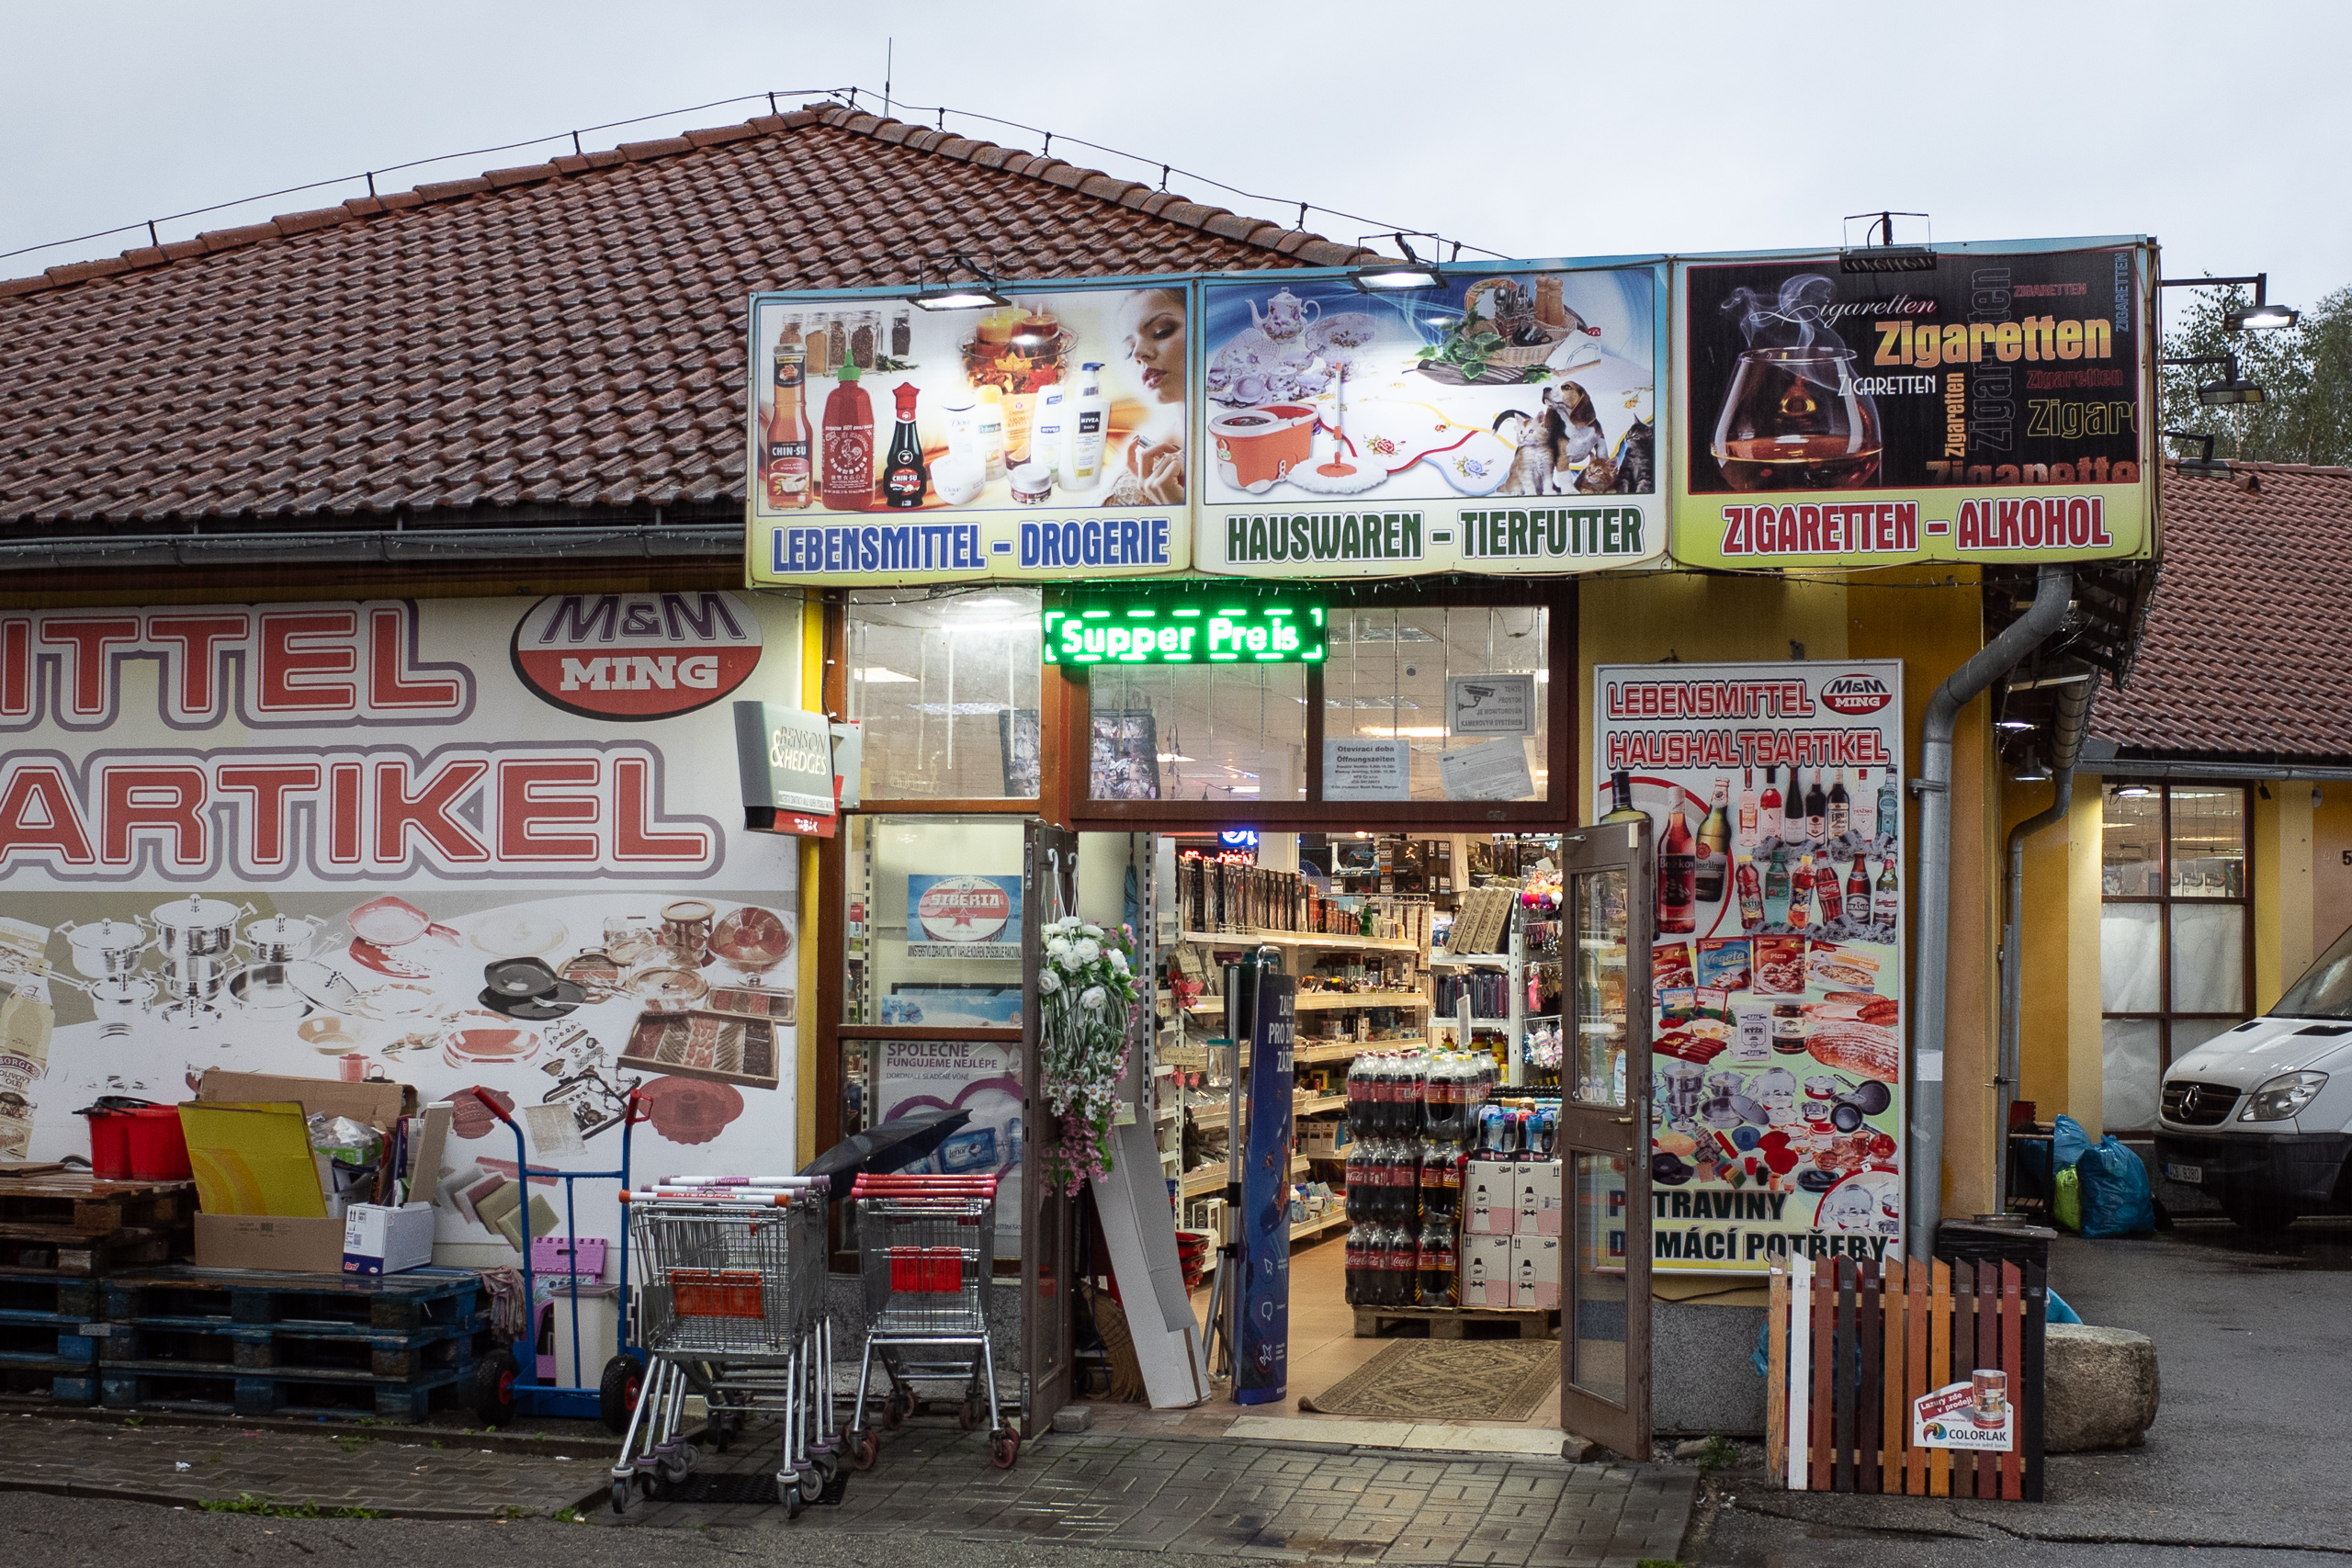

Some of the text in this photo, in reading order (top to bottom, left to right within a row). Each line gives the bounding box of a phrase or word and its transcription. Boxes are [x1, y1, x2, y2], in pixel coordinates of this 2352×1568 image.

[2013, 283, 2087, 298] ZIGARETTEN
[2115, 252, 2130, 333] ZIGARETTEN
[1874, 315, 2112, 368] Zigaretten
[2026, 368, 2124, 389] Zigaretten
[1944, 372, 1967, 457] Zigaretten
[1227, 512, 1423, 563] HAUSWAREN
[1459, 506, 1644, 558] TIERFUTTER
[1722, 502, 1918, 554] ZIGARETTEN
[1958, 497, 2111, 550] ALKOHOL
[772, 523, 987, 573] LEBENSMITTEL
[1019, 518, 1170, 569] DROGERIE
[538, 590, 747, 642] M&M
[1061, 616, 1300, 657] Supper Preis
[560, 655, 719, 691] MING
[1829, 679, 1888, 694] M&M
[1608, 682, 1815, 719] LEBENSMITTEL
[1834, 696, 1881, 707] MING
[780, 726, 828, 753] BENSON
[1608, 730, 1891, 769] HAUSHALTSARTIKEL
[929, 894, 1001, 907] SIBERIA
[1703, 951, 1746, 964] Vegeta
[1268, 1022, 1285, 1043] PRO
[887, 1057, 998, 1068] FUNGUJEME NEJLÉPE
[1498, 1166, 1511, 1174] Silan
[1518, 1167, 1531, 1175] Silan
[1606, 1190, 1789, 1222] PTRAVINY
[1494, 1239, 1508, 1247] Silan
[1544, 1241, 1557, 1249] Silan
[1606, 1227, 1889, 1264] DMÁCÍ POTŘEBY
[1920, 1393, 1962, 1410] Lazury zde
[1945, 1395, 1973, 1412] prodeji
[1949, 1428, 2007, 1442] COLORLAK
